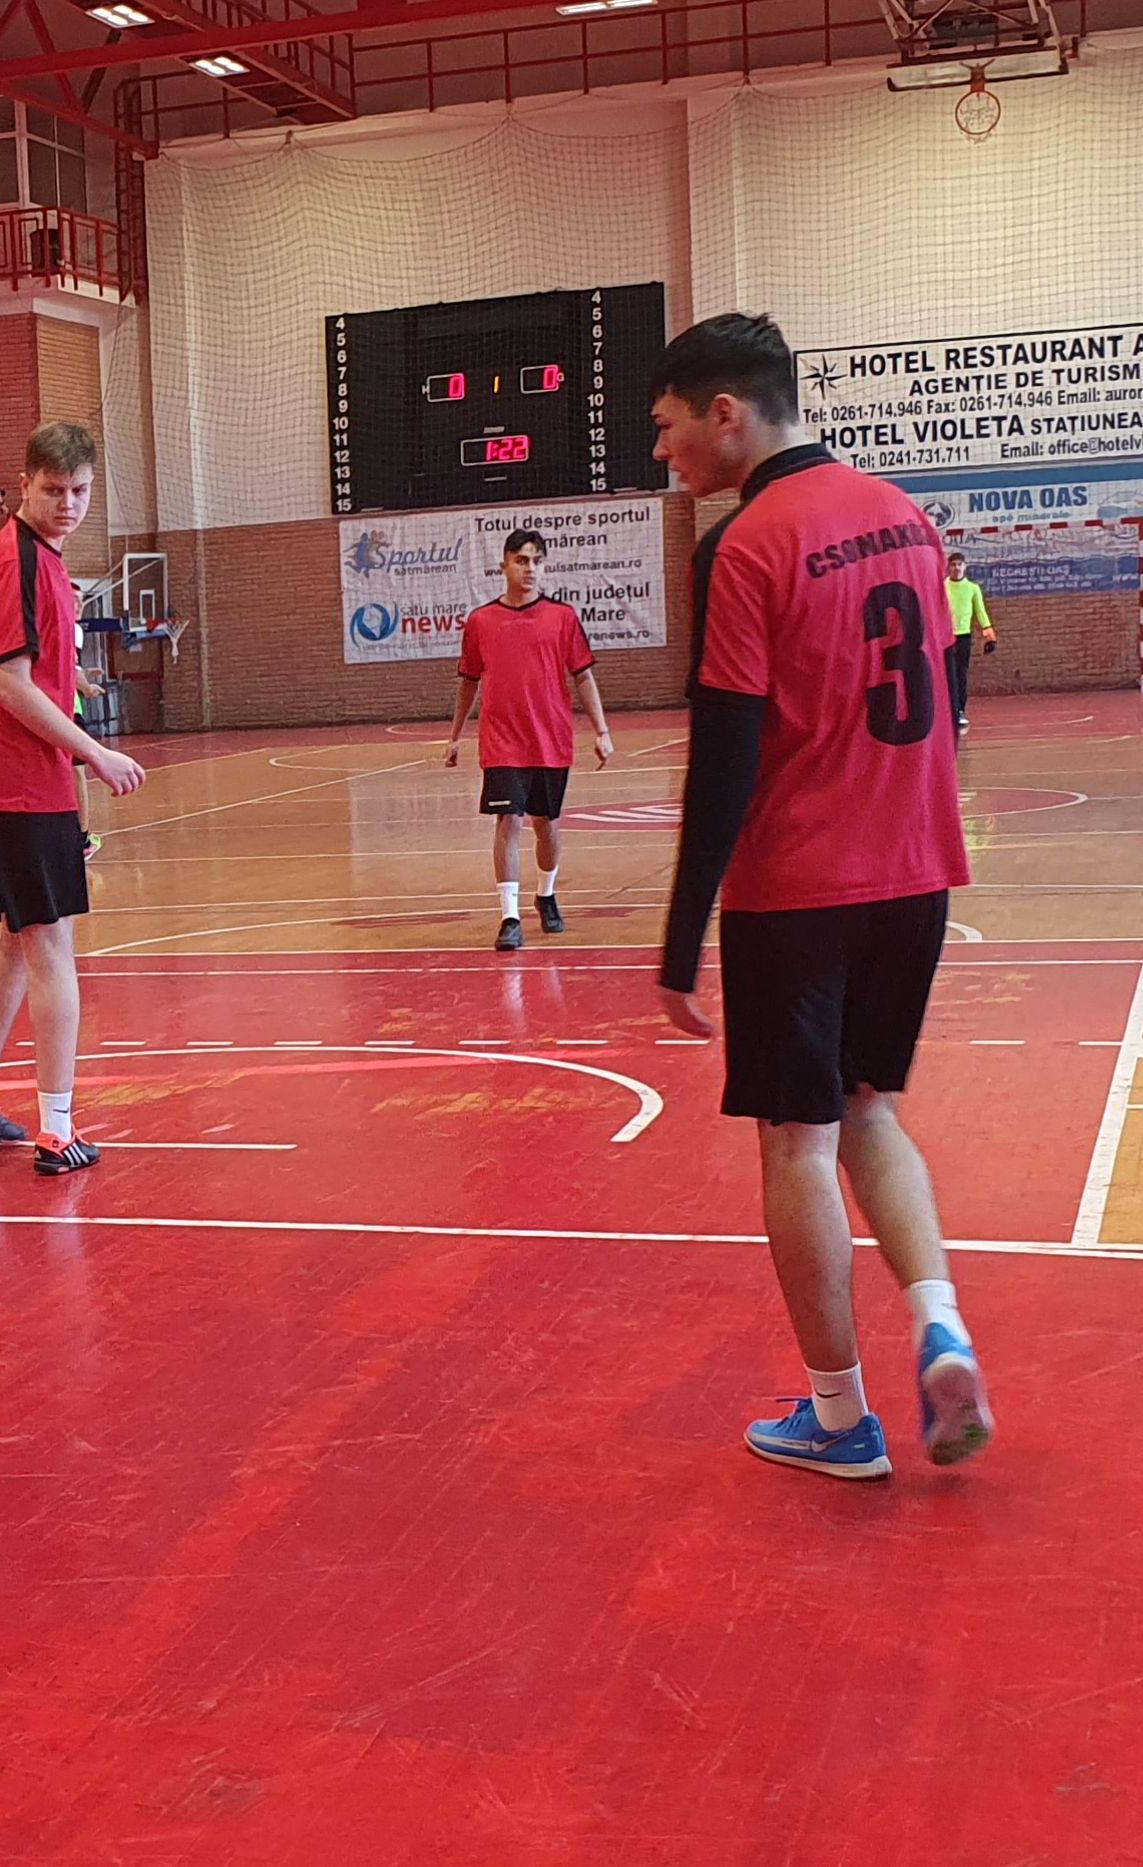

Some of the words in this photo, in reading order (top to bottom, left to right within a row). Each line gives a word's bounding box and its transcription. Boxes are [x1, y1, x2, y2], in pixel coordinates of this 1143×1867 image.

[591, 290, 602, 304] 4
[592, 307, 602, 321] 5
[336, 317, 345, 329] 4
[592, 324, 603, 338] 6
[336, 333, 346, 346] 5
[592, 341, 603, 355] 7
[337, 350, 347, 363] 6
[849, 351, 936, 378] HOTEL
[944, 334, 1124, 371] RESTAURANT
[337, 366, 347, 379] 7
[593, 359, 603, 372] 8
[543, 365, 558, 389] 0
[593, 376, 604, 389] 9
[1015, 370, 1045, 388] DE
[1051, 363, 1140, 386] TURISM
[338, 383, 348, 396] 8
[421, 384, 429, 395] H
[449, 374, 464, 399] 0
[338, 399, 348, 412] 9
[587, 393, 604, 407] 10
[803, 408, 827, 424] Tel:
[831, 401, 922, 421] 0261-714.946
[926, 399, 956, 415] Fax:
[959, 391, 1053, 411] 0261-714.946
[1057, 387, 1101, 405] Email:
[1105, 387, 1143, 401] auror
[332, 417, 349, 430] 10
[587, 410, 604, 424] 11
[588, 427, 605, 441] 12
[820, 423, 904, 449] HOTEL
[913, 414, 1025, 443] VIOLETA
[333, 433, 348, 446] 11
[334, 449, 350, 463] 12
[486, 437, 529, 462] 1:22
[589, 444, 606, 457] 13
[879, 447, 969, 466] 0241-731.711
[1000, 442, 1044, 459] Email:
[1048, 434, 1143, 455] office@hotelv
[335, 466, 351, 479] 13
[589, 461, 606, 475] 14
[335, 482, 351, 495] 14
[590, 478, 607, 491] 15
[336, 498, 352, 511] 15
[968, 490, 1033, 513] NOVA
[474, 516, 518, 532] Totul
[522, 514, 582, 530] despre
[588, 507, 650, 527] sportul
[544, 533, 608, 549] mărean
[373, 538, 464, 573] Sportul
[552, 586, 581, 602] din
[400, 603, 430, 617] satu
[432, 602, 467, 615] mare
[581, 606, 626, 623] Mare
[401, 613, 467, 634] news
[588, 629, 650, 641] renews.ro
[863, 581, 935, 746] 3
